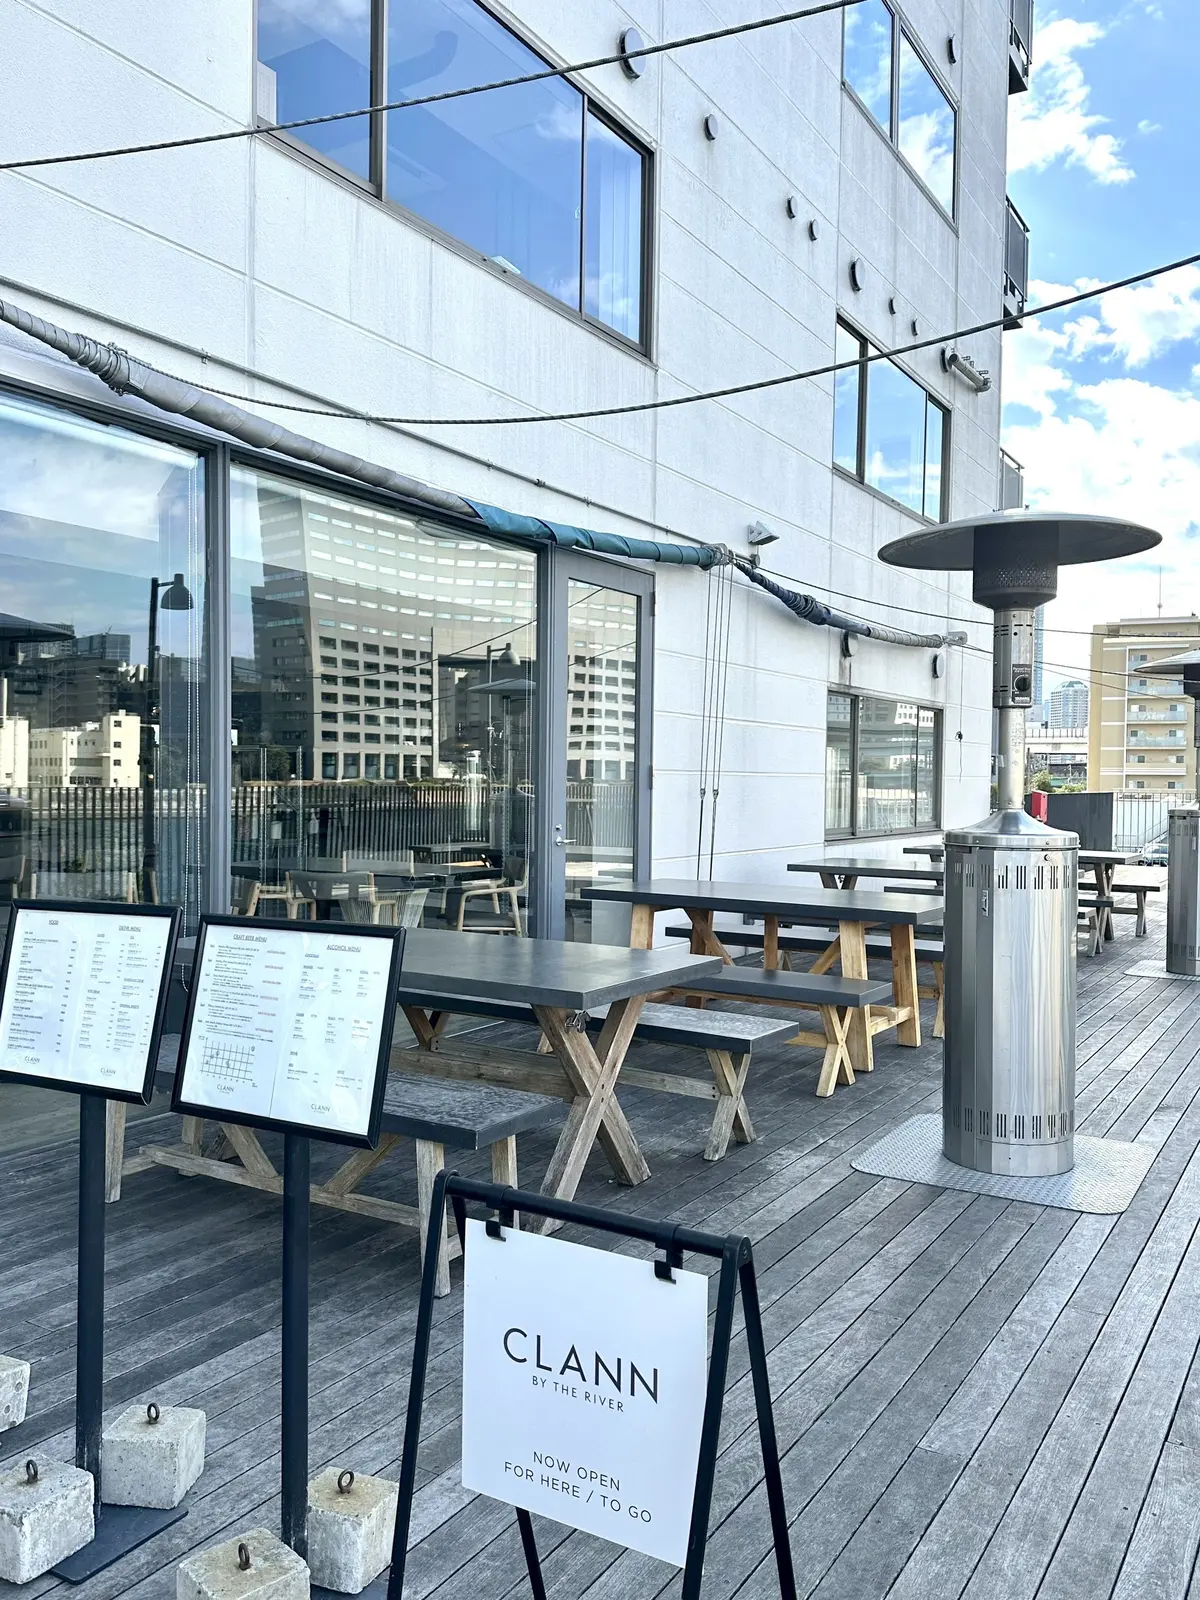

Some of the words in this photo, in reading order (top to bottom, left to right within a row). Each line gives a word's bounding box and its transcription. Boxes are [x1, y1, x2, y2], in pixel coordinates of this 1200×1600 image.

[326, 944, 347, 952] ALCOHOL
[25, 1055, 40, 1063] CLANN
[100, 1067, 116, 1075] CLANN
[217, 1083, 235, 1092] CLANN
[311, 1103, 331, 1112] CLANN
[503, 1327, 659, 1405] CLANN
[532, 1375, 547, 1388] BY
[553, 1382, 578, 1398] THE
[584, 1391, 625, 1413] RIVER
[533, 1451, 571, 1474] NOW
[577, 1466, 620, 1492] OPEN
[504, 1461, 534, 1482] FOR
[540, 1474, 580, 1499] HERE
[586, 1490, 595, 1504] /
[599, 1495, 622, 1513] TO
[628, 1506, 652, 1523] GO
